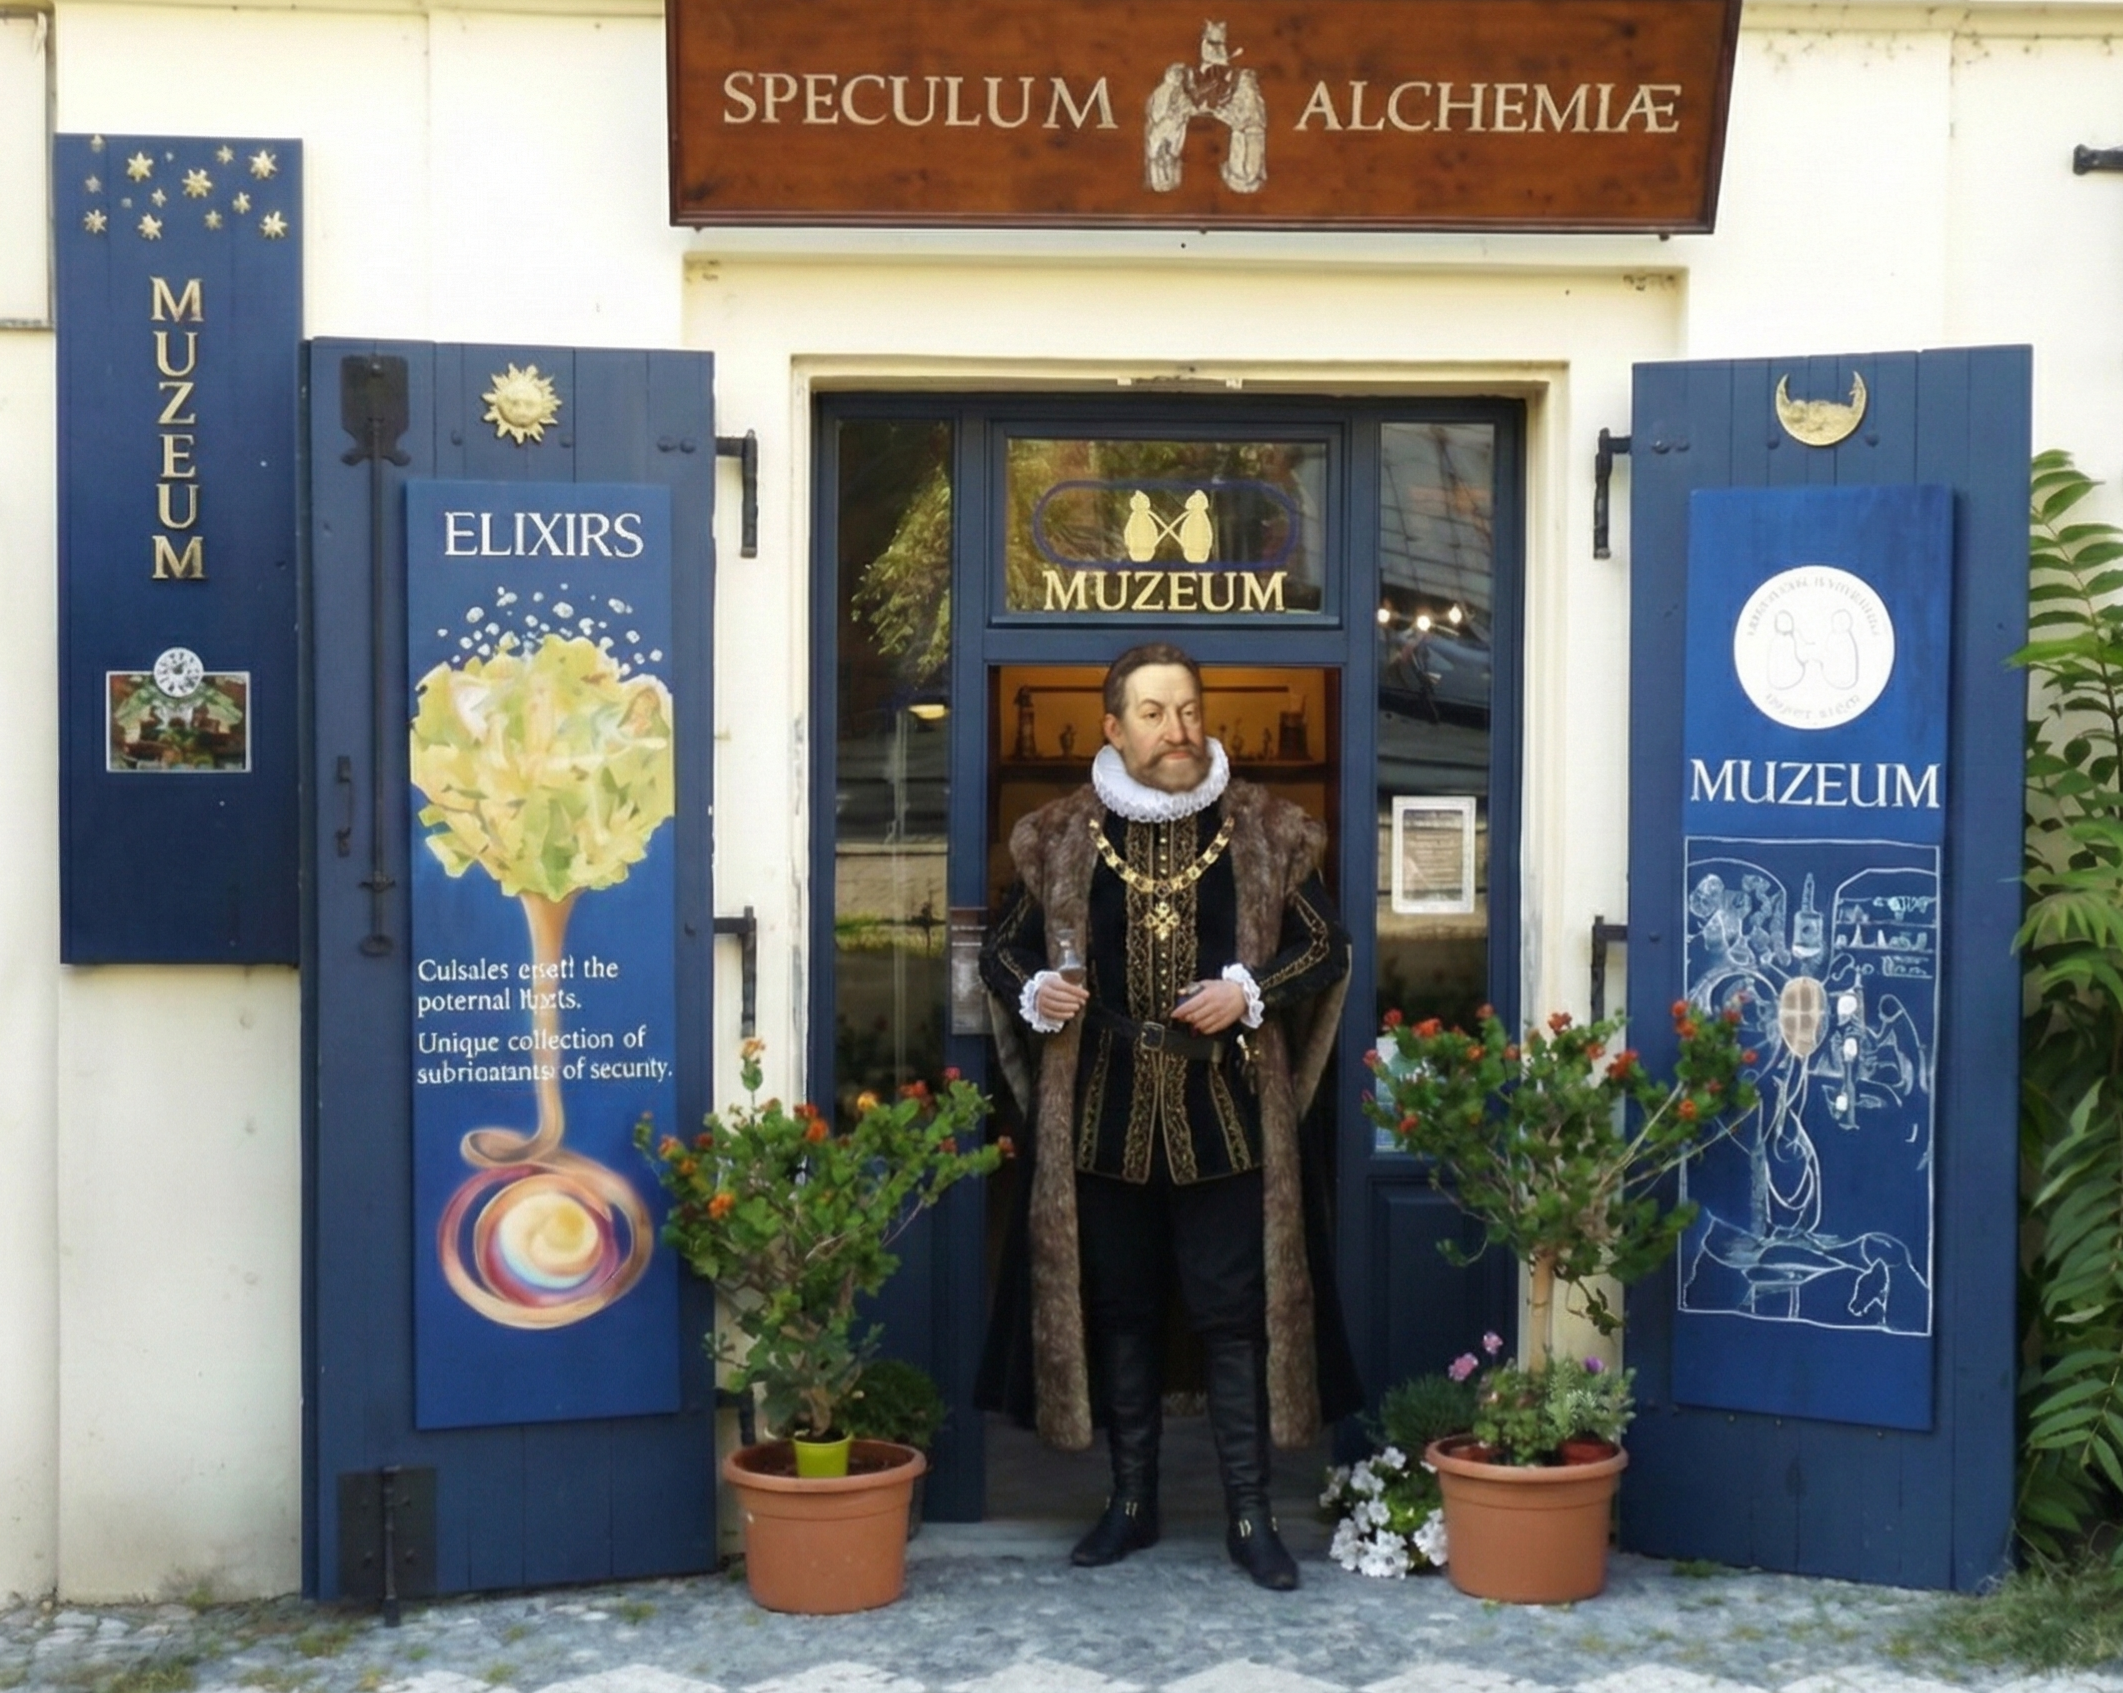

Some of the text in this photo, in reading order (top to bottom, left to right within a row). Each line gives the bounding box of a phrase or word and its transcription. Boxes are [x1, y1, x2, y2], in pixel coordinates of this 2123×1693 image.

[723, 70, 1682, 134] SPECULUM ALCHEMIÆ
[149, 276, 205, 581] MUZEUM
[444, 511, 645, 559] ELIXIRS
[1042, 570, 1288, 612] MUZEUM
[1690, 758, 1941, 809] MUZEUM
[584, 955, 619, 979] the
[417, 987, 511, 1018] poternal
[418, 1024, 647, 1058] Unique collection of
[562, 1056, 586, 1080] of
